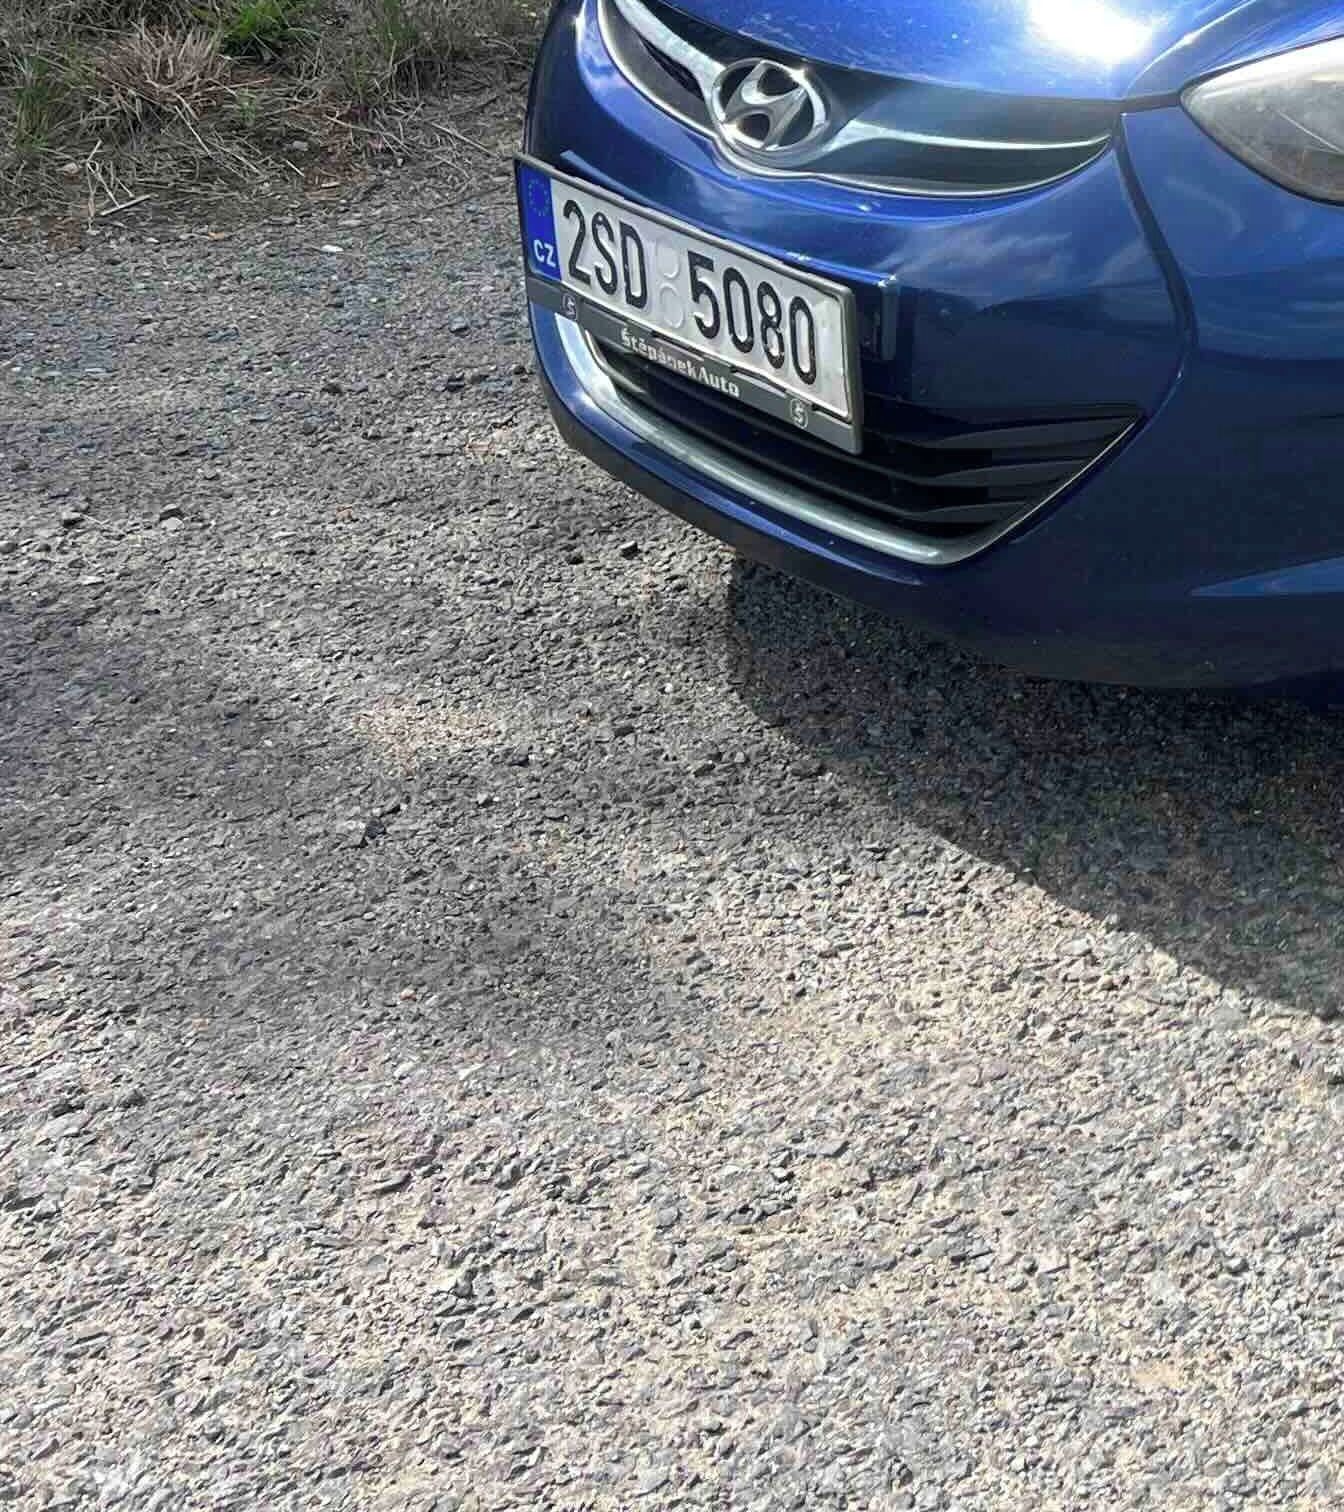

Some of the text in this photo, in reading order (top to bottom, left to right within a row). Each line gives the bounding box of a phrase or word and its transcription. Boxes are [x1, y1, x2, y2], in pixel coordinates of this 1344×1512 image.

[533, 239, 557, 268] CZ
[563, 199, 816, 384] 2SD 5080
